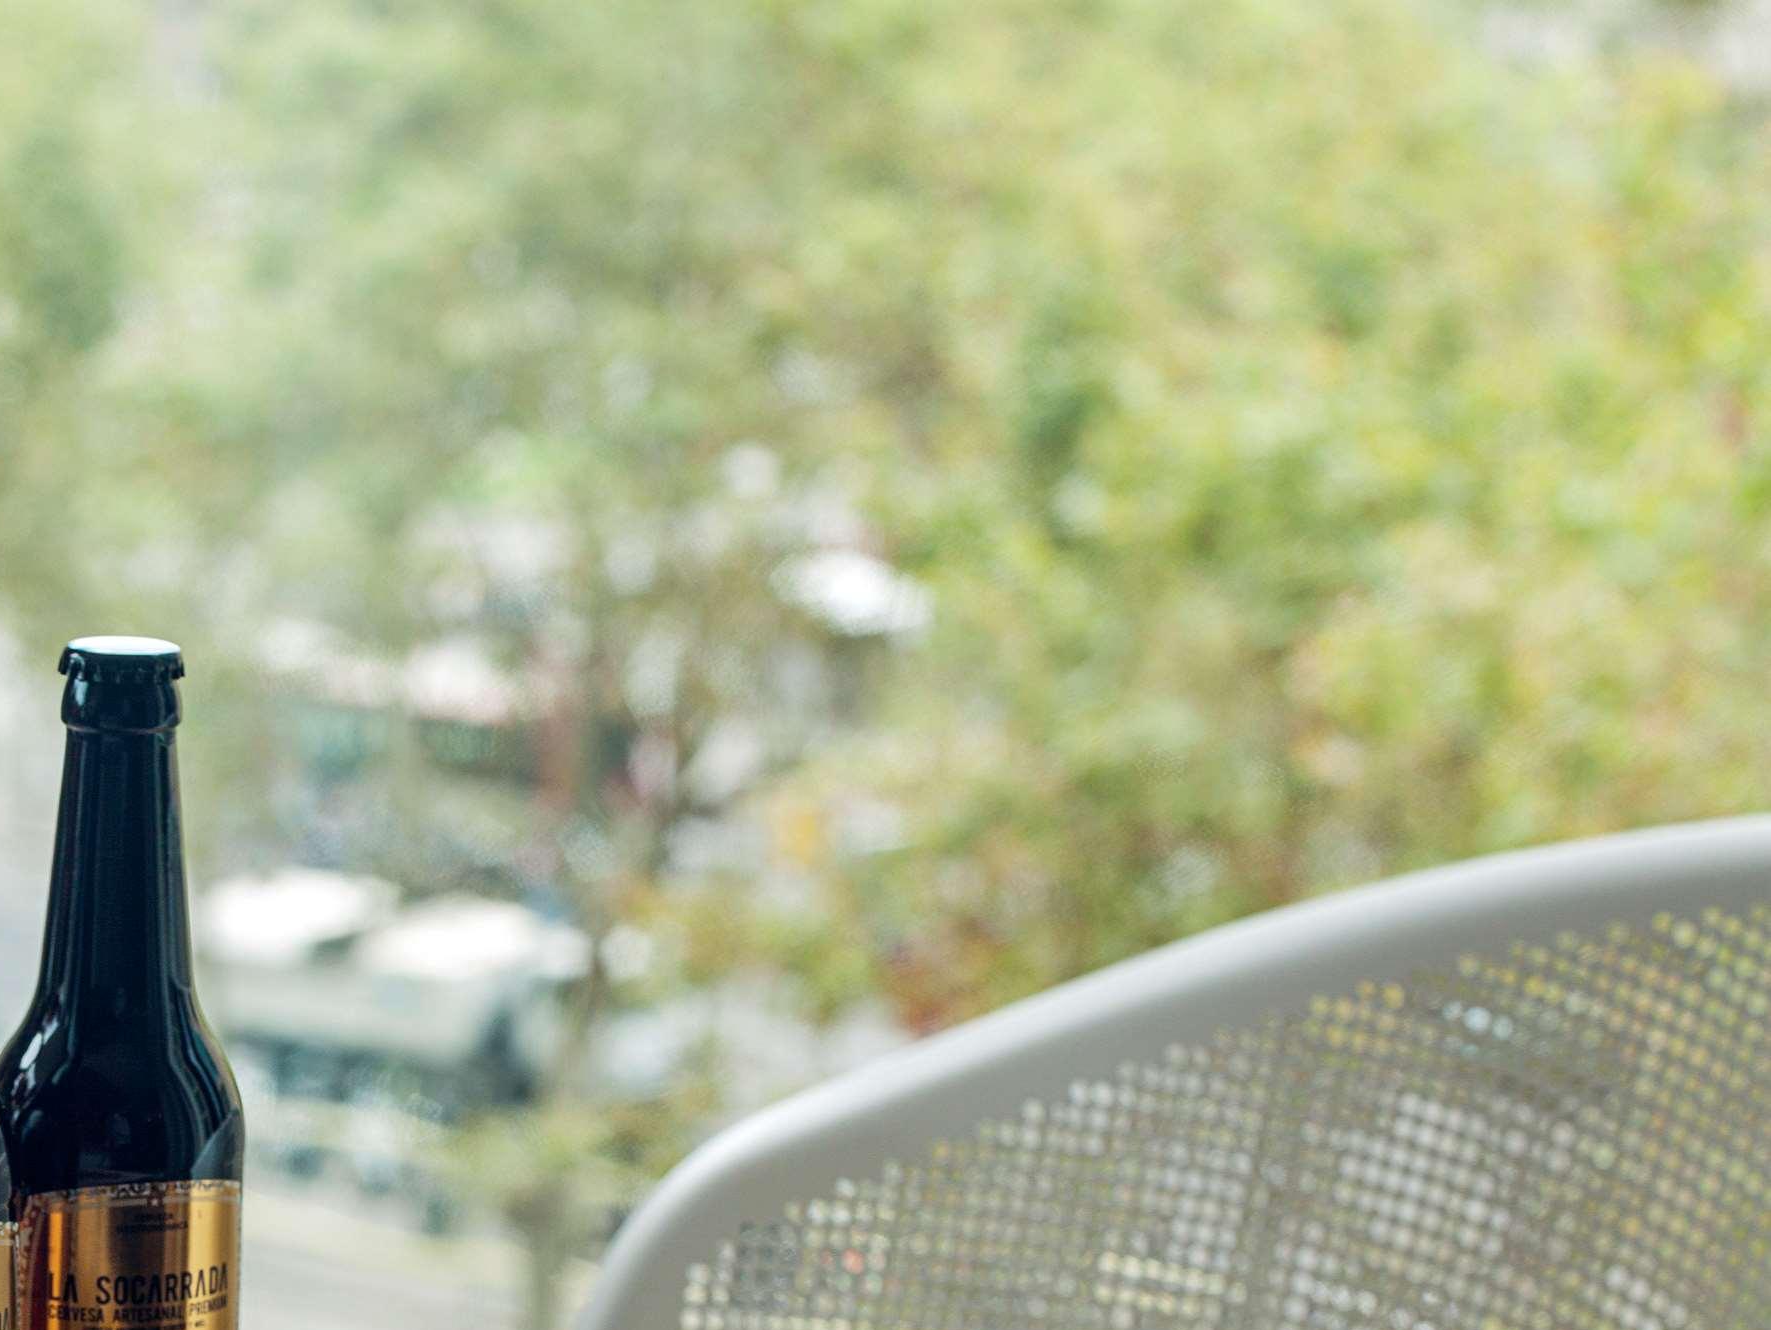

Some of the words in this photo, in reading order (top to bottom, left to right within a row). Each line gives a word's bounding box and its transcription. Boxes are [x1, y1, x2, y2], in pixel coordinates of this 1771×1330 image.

[49, 1273, 78, 1303] LA
[95, 1263, 228, 1305] SOCARRADA
[48, 1304, 104, 1323] CERVESA
[113, 1304, 185, 1323] ARTESANAL
